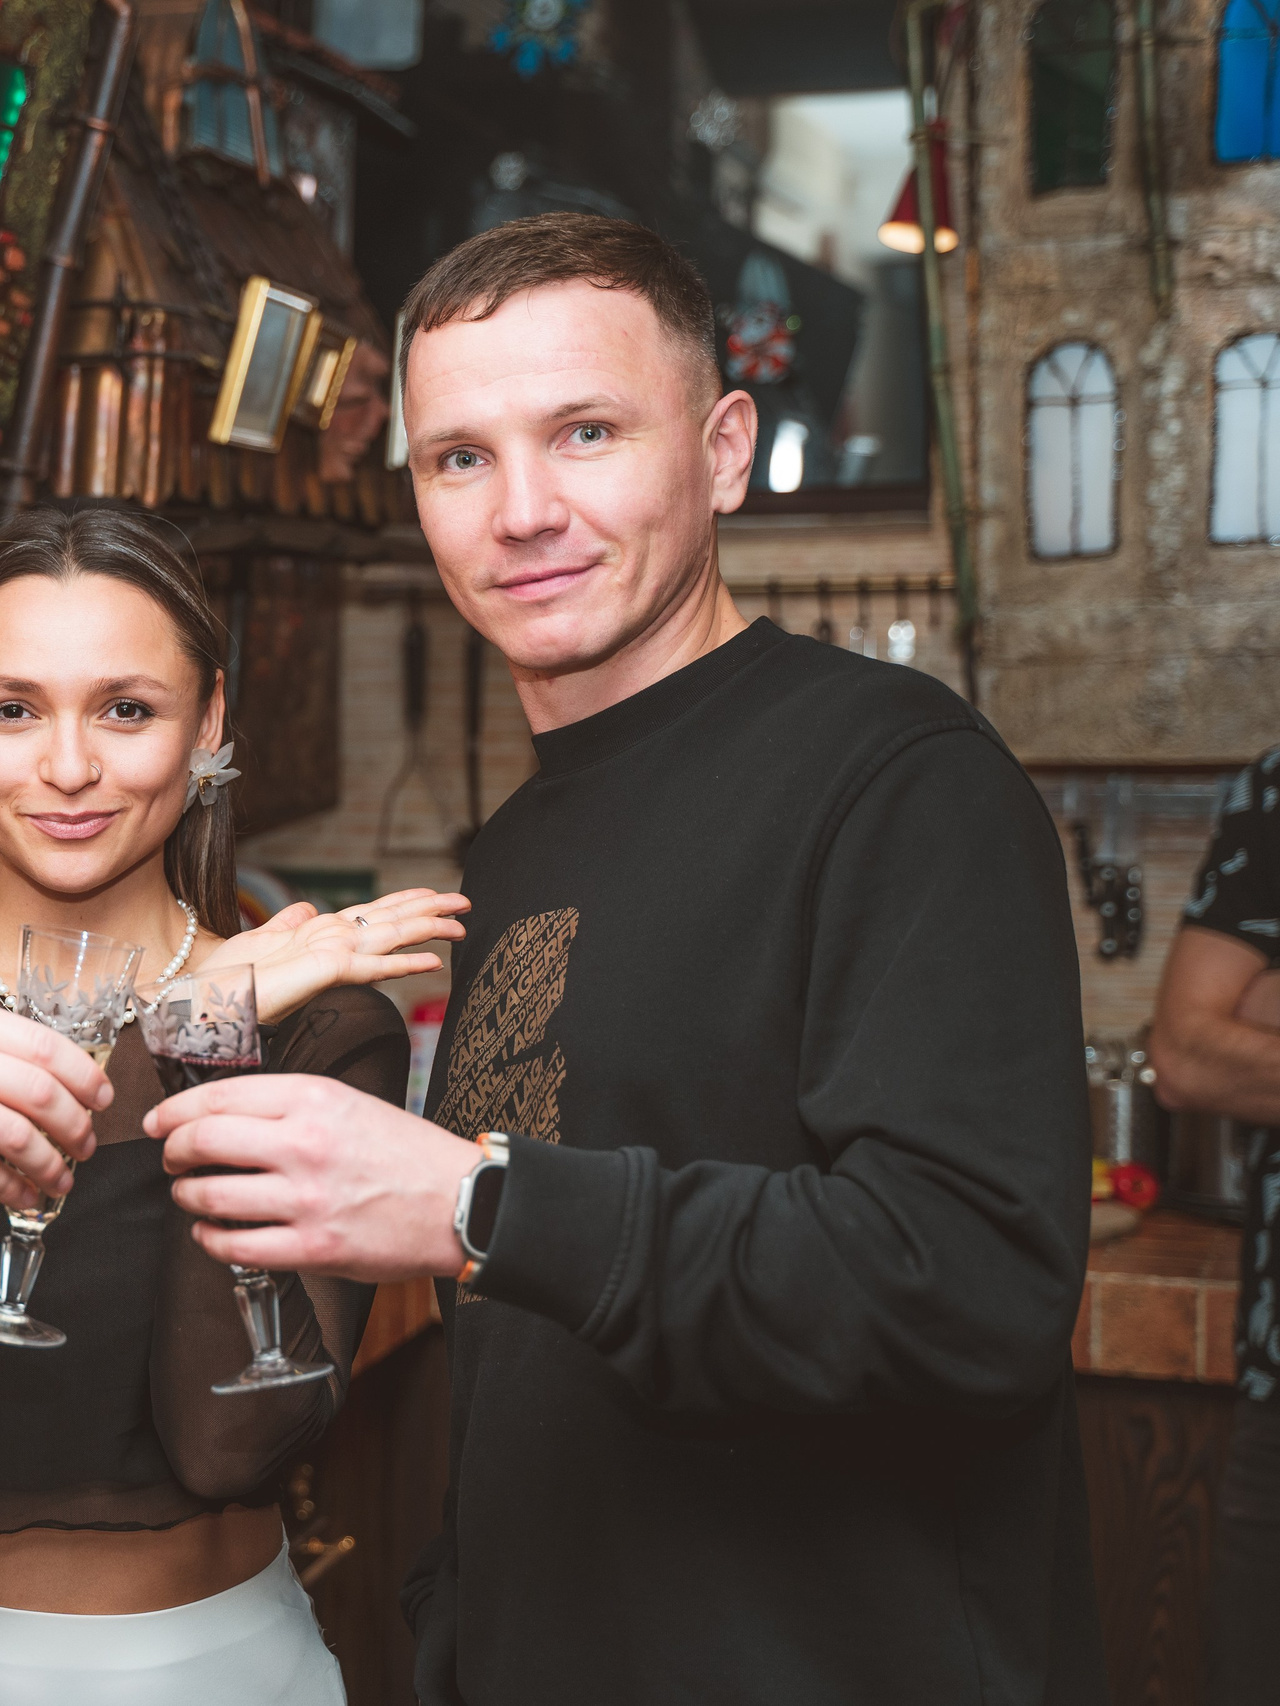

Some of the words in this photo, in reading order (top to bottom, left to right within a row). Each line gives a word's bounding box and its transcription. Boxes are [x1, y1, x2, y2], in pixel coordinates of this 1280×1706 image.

[519, 935, 547, 972] KARL
[449, 1075, 473, 1109] KARL
[471, 1008, 525, 1080] LAGERFELD
[525, 978, 550, 1015] KARL
